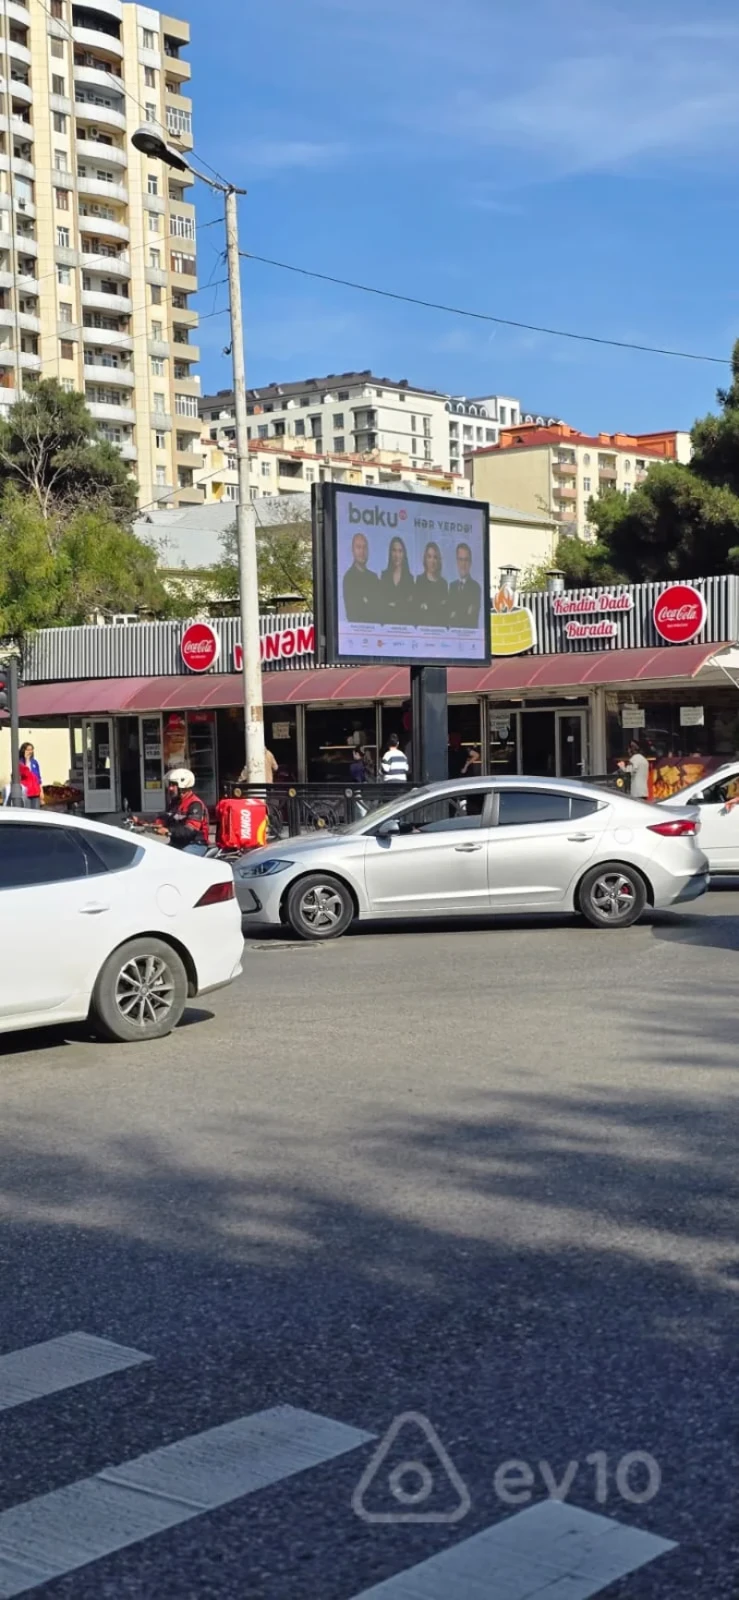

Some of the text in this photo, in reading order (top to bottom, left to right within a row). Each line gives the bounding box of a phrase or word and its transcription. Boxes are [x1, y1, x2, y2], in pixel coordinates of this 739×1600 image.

[348, 501, 398, 528] baku
[566, 621, 613, 637] Burada
[240, 809, 252, 840] YANGO
